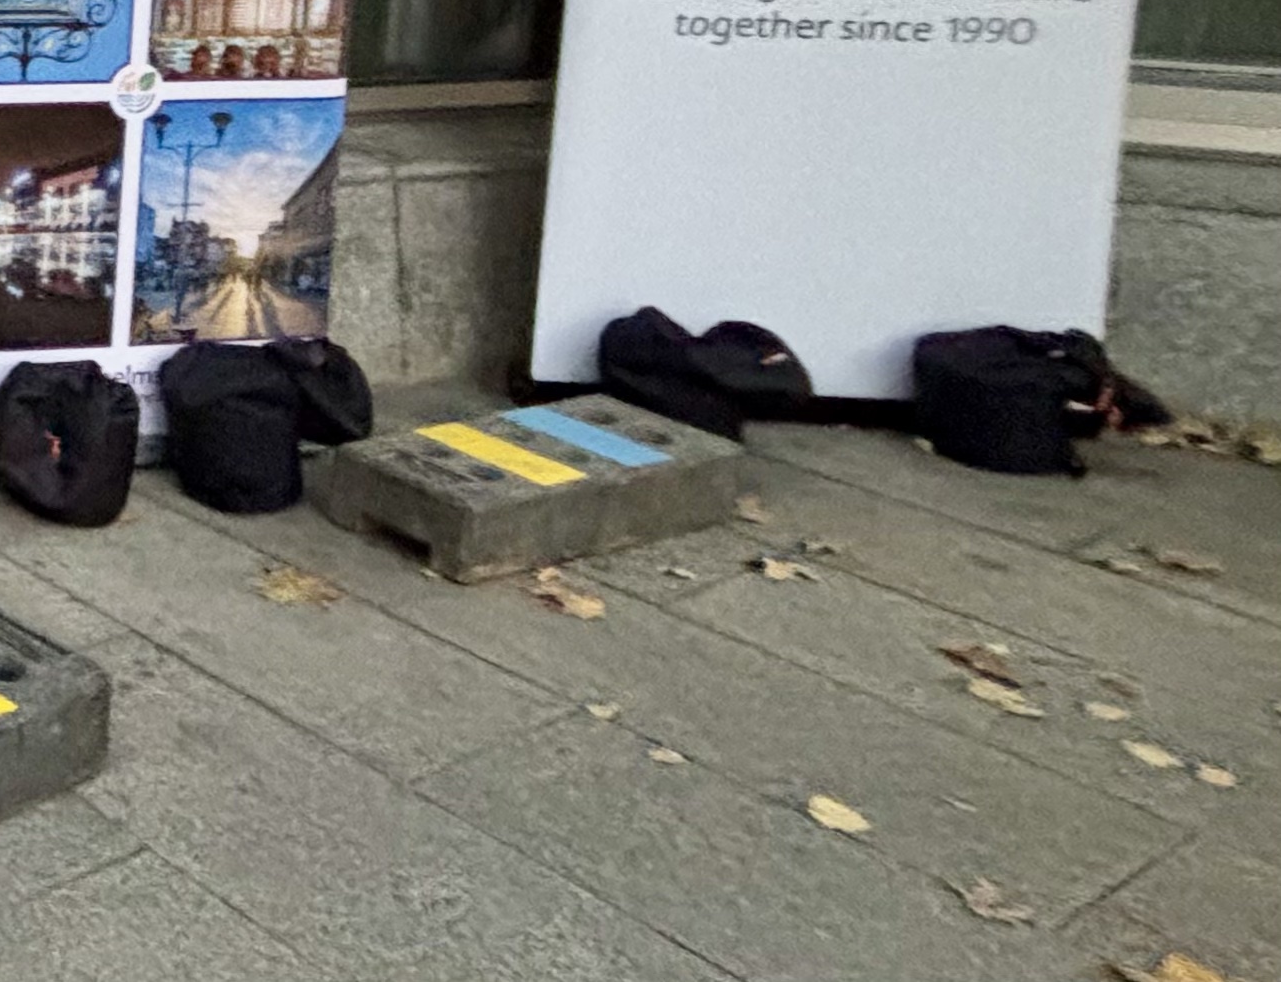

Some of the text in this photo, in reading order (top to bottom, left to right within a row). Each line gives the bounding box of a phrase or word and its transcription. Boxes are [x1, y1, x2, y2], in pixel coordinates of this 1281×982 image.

[675, 11, 1038, 46] together since 1990
